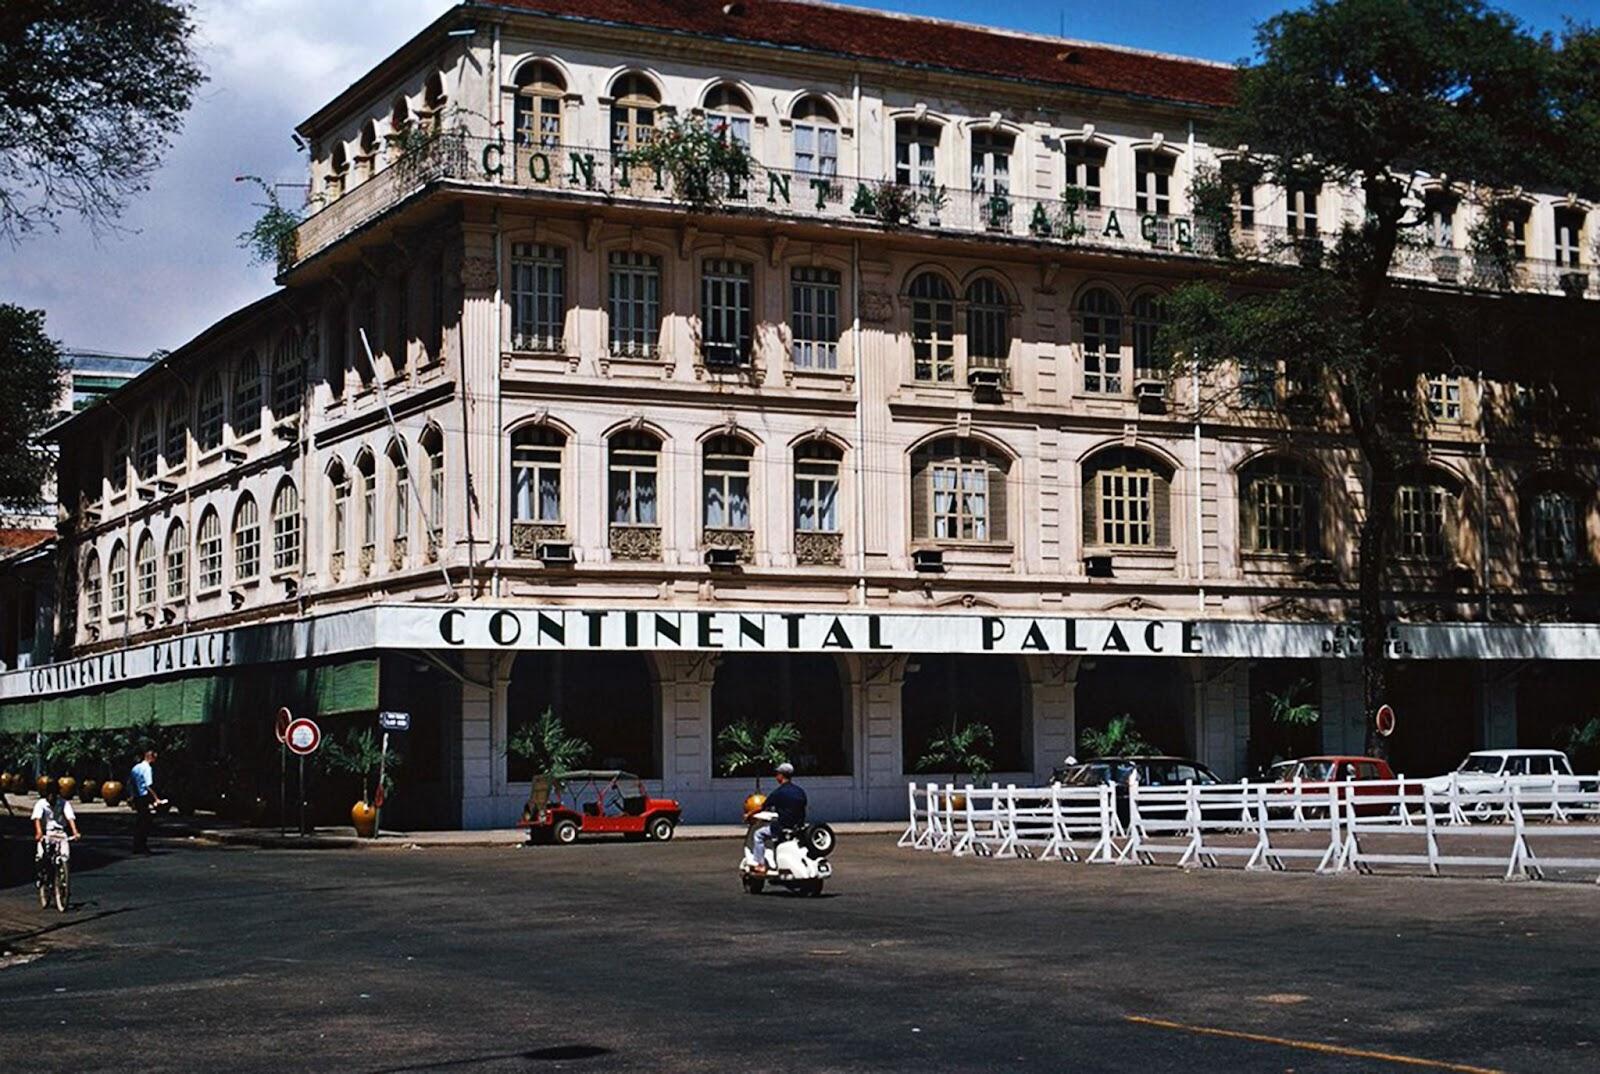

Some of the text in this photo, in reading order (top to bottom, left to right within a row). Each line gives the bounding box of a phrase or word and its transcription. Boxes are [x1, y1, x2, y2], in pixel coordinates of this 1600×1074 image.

[439, 609, 1203, 653] CONTINENTAL PALACE
[30, 633, 232, 693] CONTINENTAL PALACE
